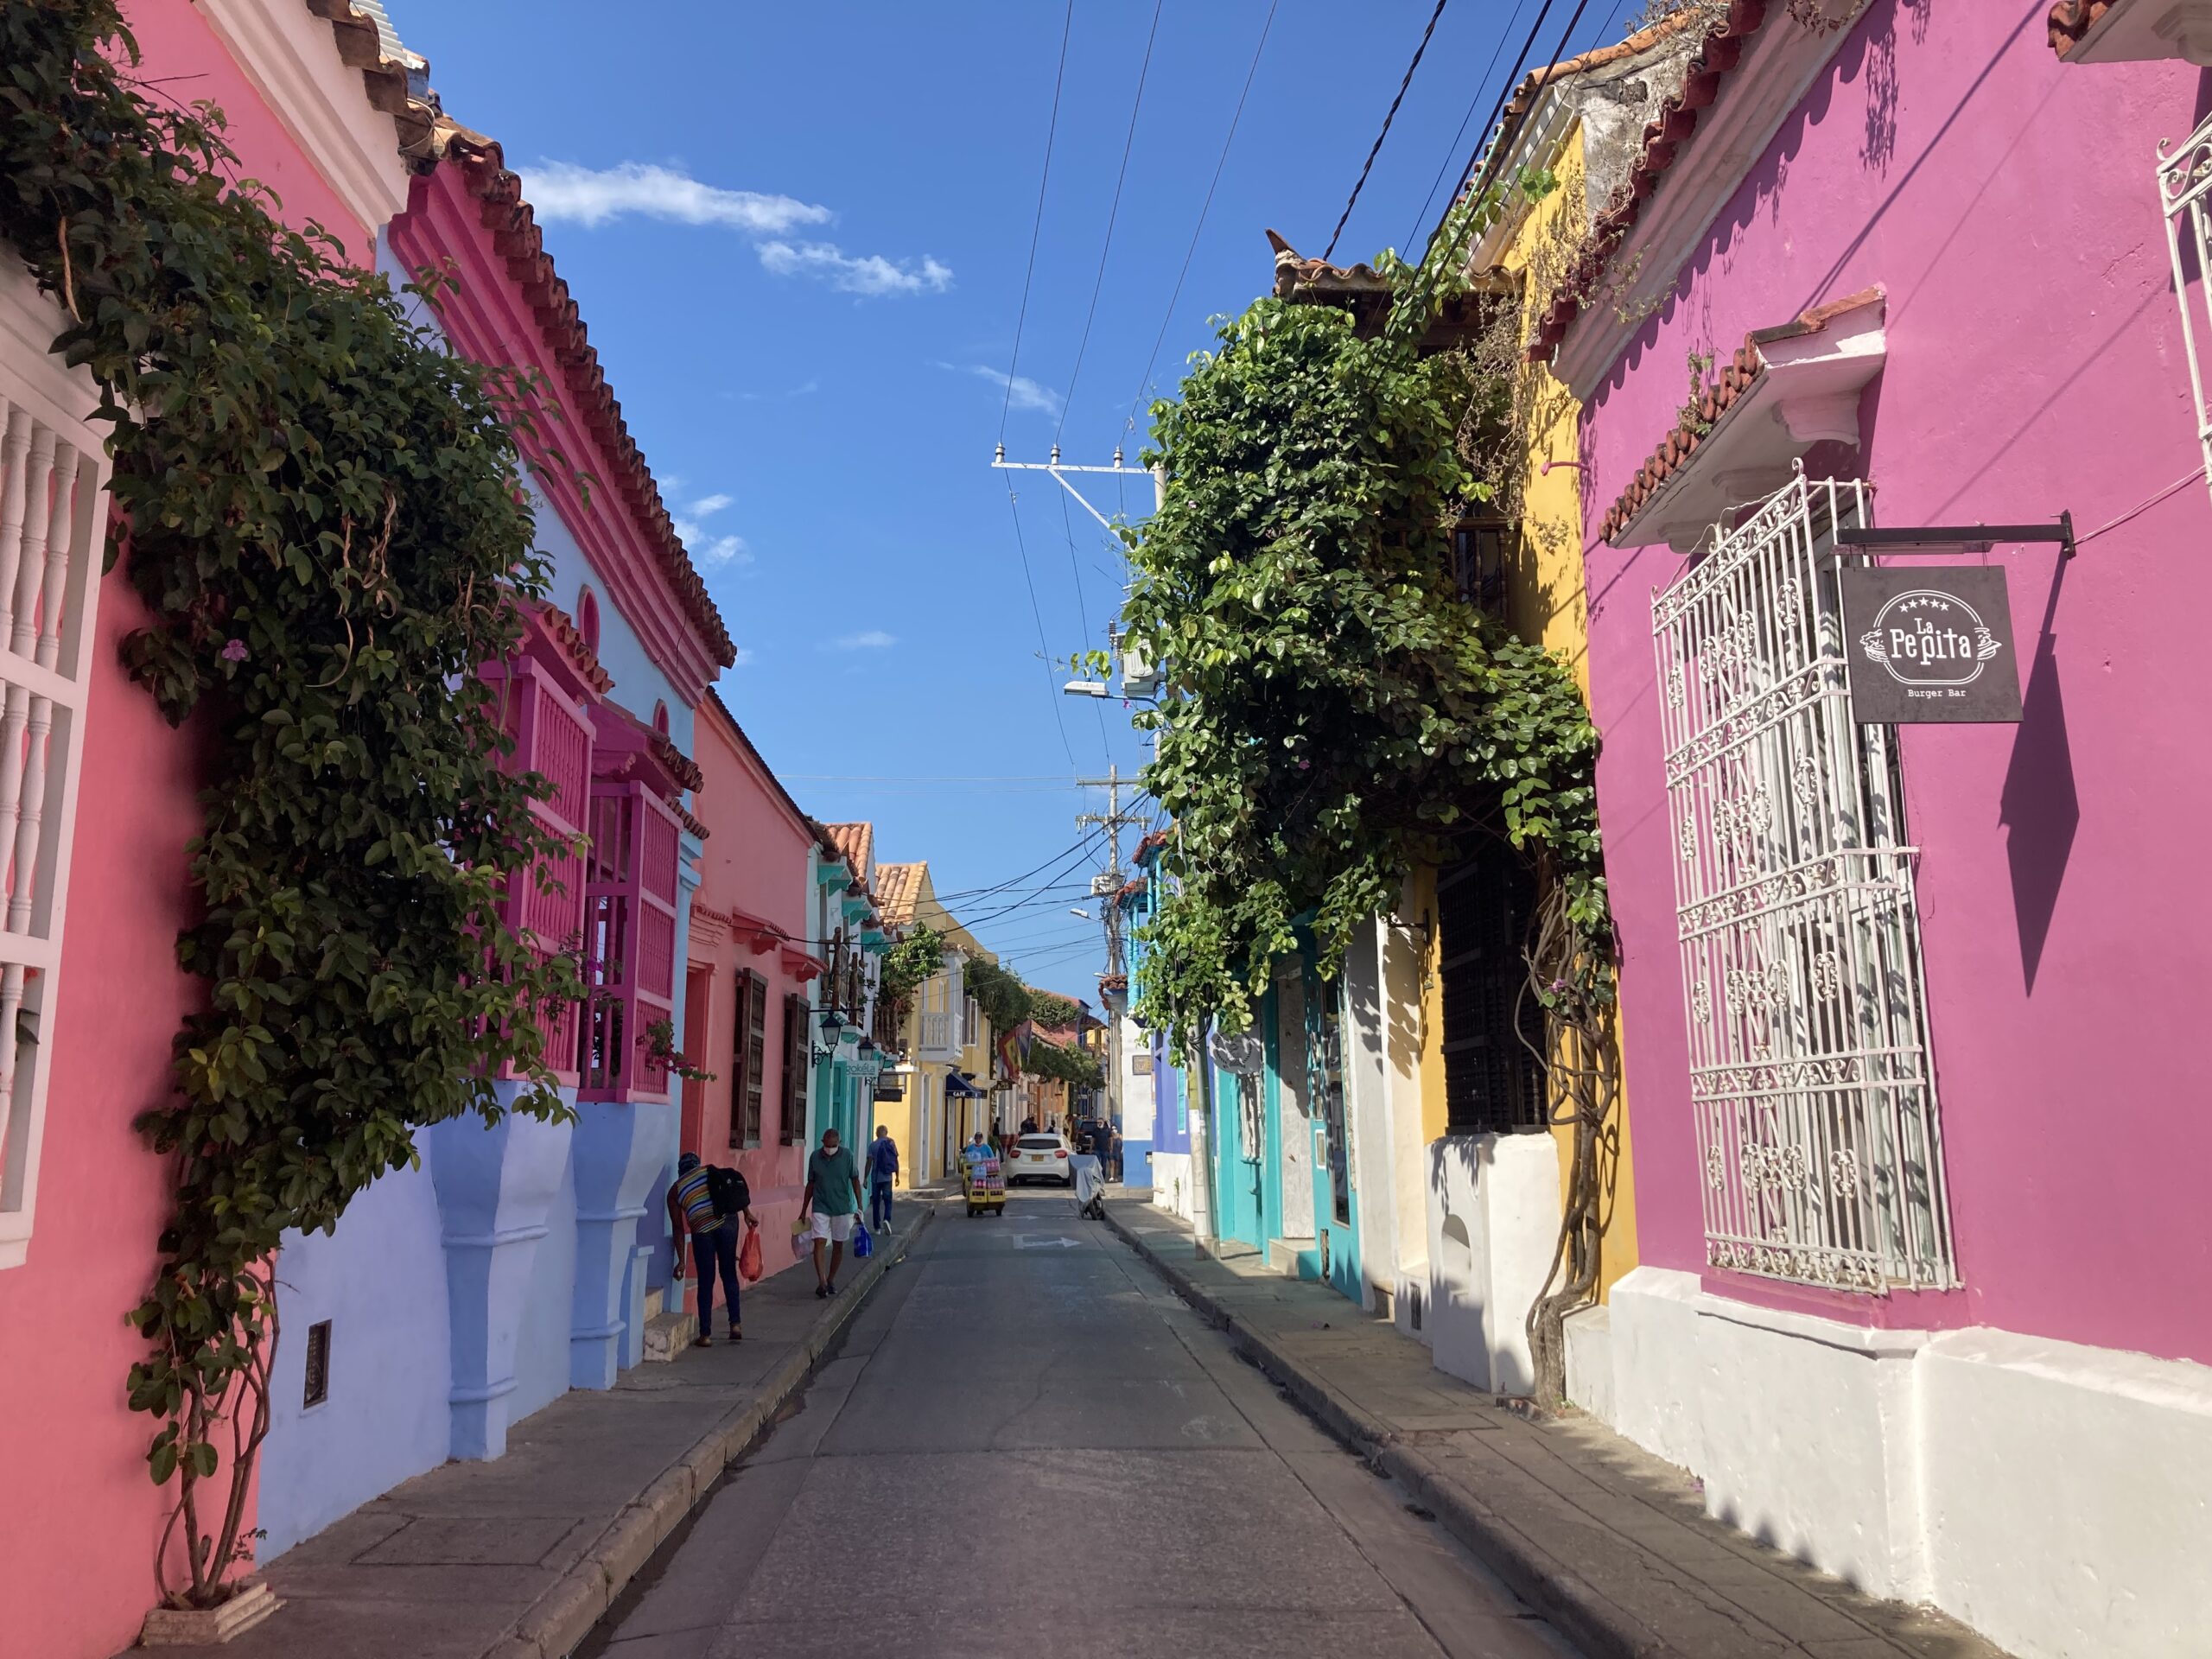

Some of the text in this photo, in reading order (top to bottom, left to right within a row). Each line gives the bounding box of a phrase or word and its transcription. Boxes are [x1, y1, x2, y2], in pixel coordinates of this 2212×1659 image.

[1914, 617, 1934, 634] La
[1890, 628, 1972, 665] Pepita
[1907, 689, 1967, 699] Burger Bar
[846, 1063, 876, 1075] gokéla
